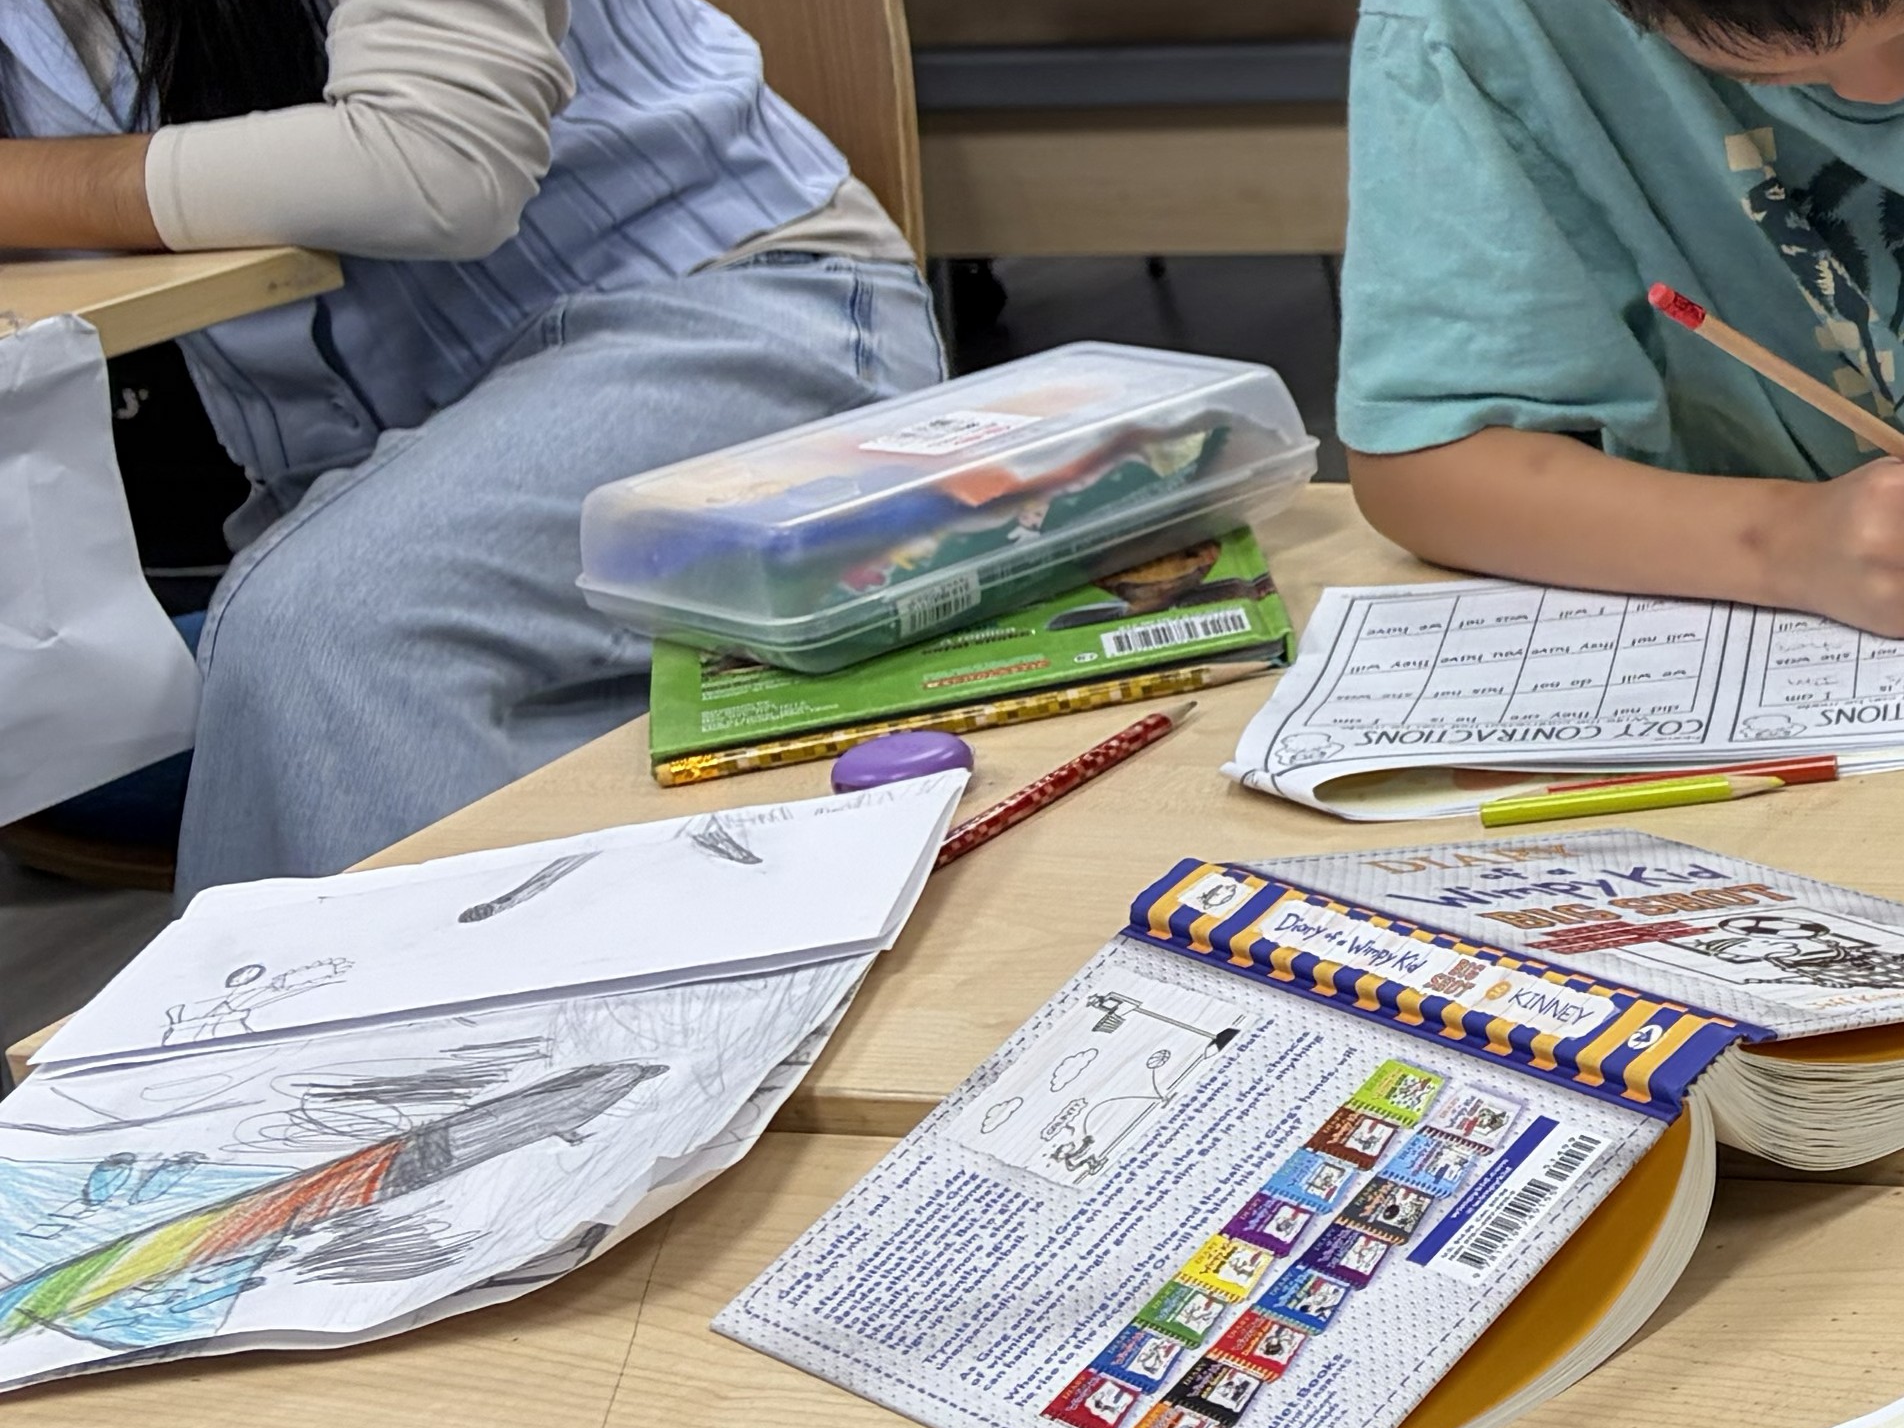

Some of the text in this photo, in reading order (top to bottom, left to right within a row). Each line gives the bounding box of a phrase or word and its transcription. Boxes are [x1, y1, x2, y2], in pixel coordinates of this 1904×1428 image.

[1355, 720, 1703, 746] COZY CONTRACTIONS
[1367, 843, 1583, 876] DIARY
[1386, 863, 1734, 910] Wimpy Kid
[1475, 883, 1798, 930] BIG SHOT
[1274, 912, 1326, 943] Diary
[1348, 935, 1395, 969] Wimpy
[1394, 947, 1428, 974] Kid
[1424, 972, 1477, 998] SHOT
[1450, 958, 1487, 981] BIG
[1508, 987, 1594, 1027] KINNEY
[1293, 1350, 1346, 1398] Books
